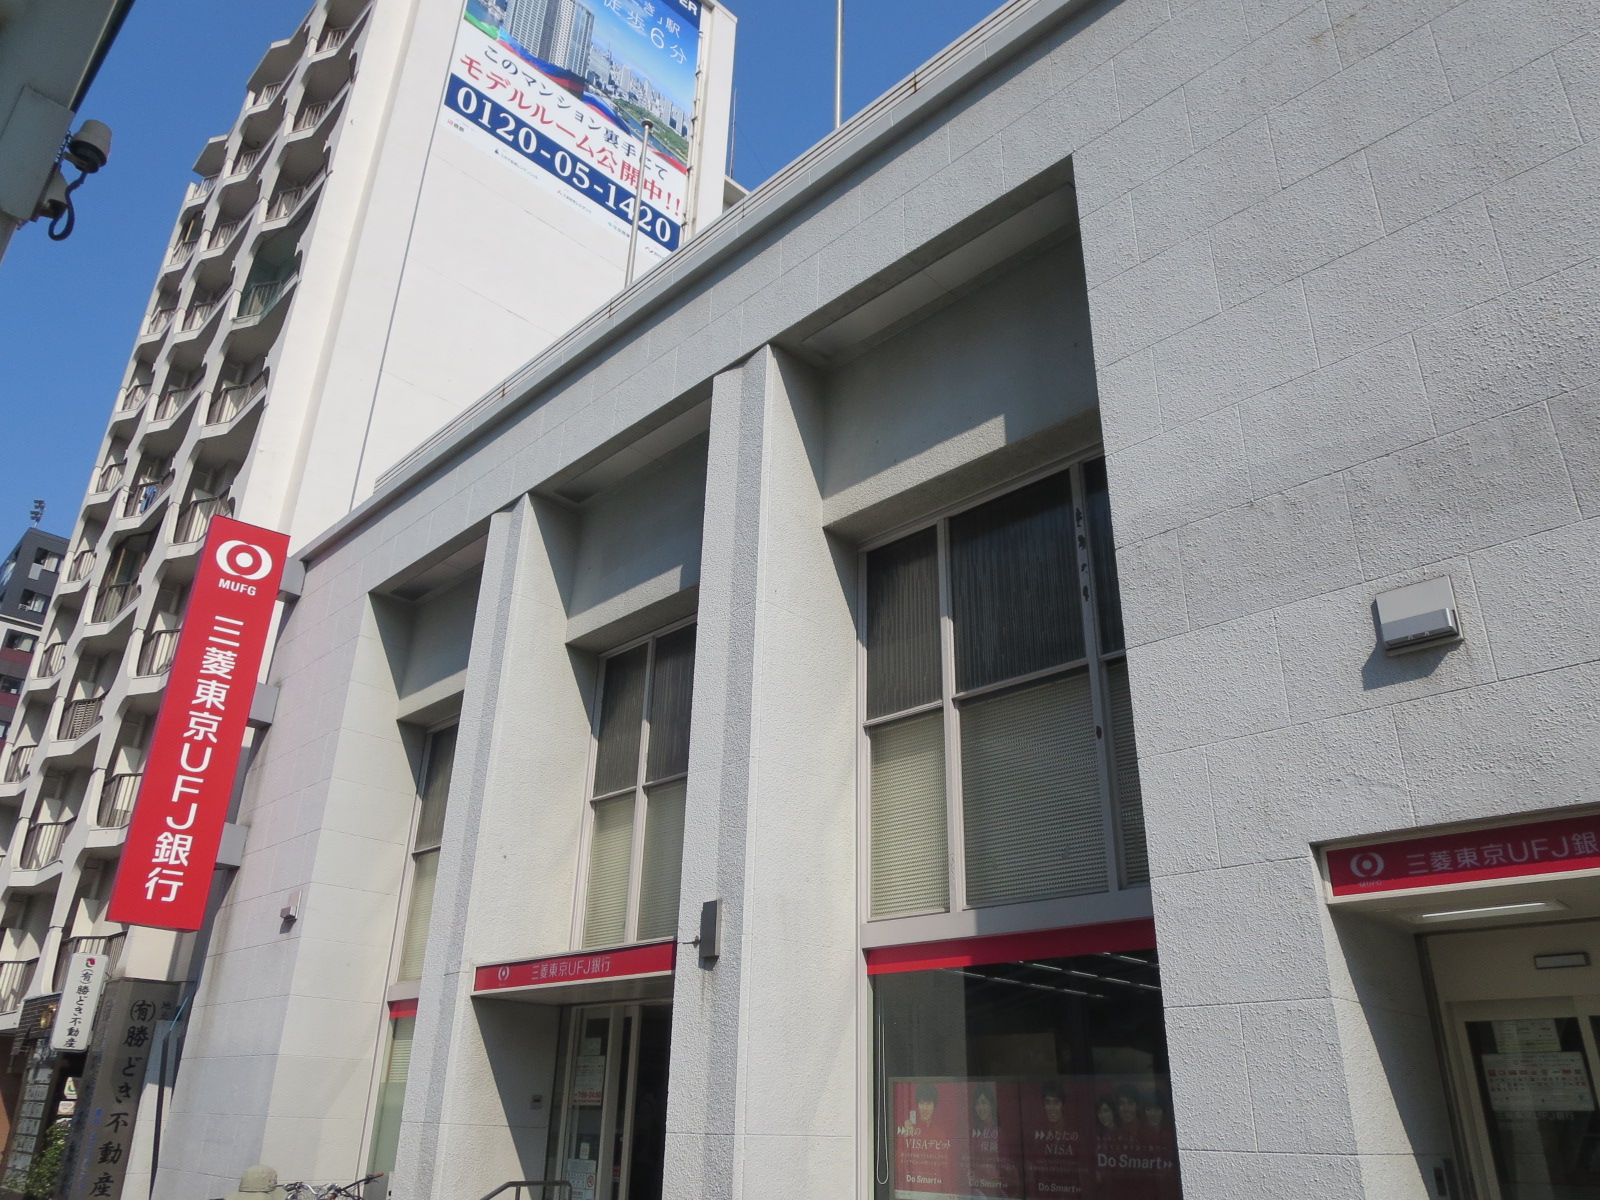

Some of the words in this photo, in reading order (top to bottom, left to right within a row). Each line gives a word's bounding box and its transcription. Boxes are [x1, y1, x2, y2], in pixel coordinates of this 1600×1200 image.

[484, 45, 668, 181] このマンション裏手にて
[457, 86, 671, 243] 0120-05-1420
[218, 578, 257, 597] MUFG
[145, 615, 245, 903] 三菱東京UFJ銀行
[1406, 832, 1600, 875] 三菱東京UFJ銀
[531, 957, 611, 981] 三菱東京UFJ銀行
[1045, 1143, 1073, 1155] NISA
[1097, 1153, 1117, 1167] Do
[1118, 1154, 1162, 1169] Smart
[906, 1174, 916, 1183] Do
[916, 1175, 937, 1184] Smart
[1038, 1182, 1050, 1192] Do
[1050, 1183, 1076, 1193] Smart
